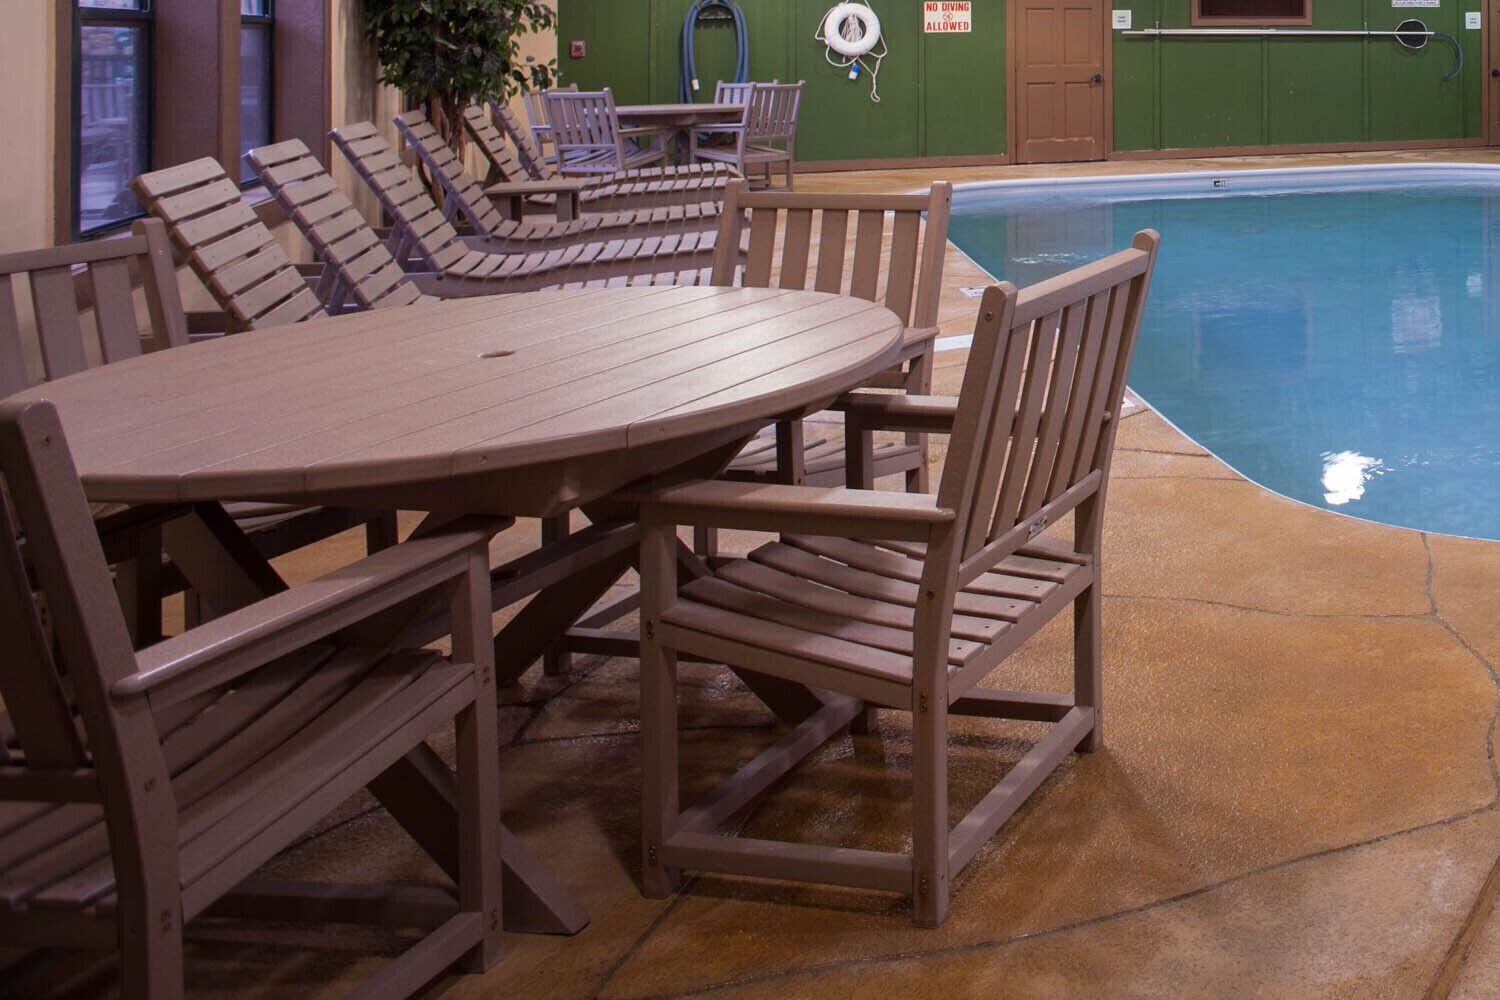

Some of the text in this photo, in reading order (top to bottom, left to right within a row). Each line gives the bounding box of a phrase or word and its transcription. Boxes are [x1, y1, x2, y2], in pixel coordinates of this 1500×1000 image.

[926, 2, 969, 12] NO DIVING
[926, 21, 969, 31] ALLOWED
